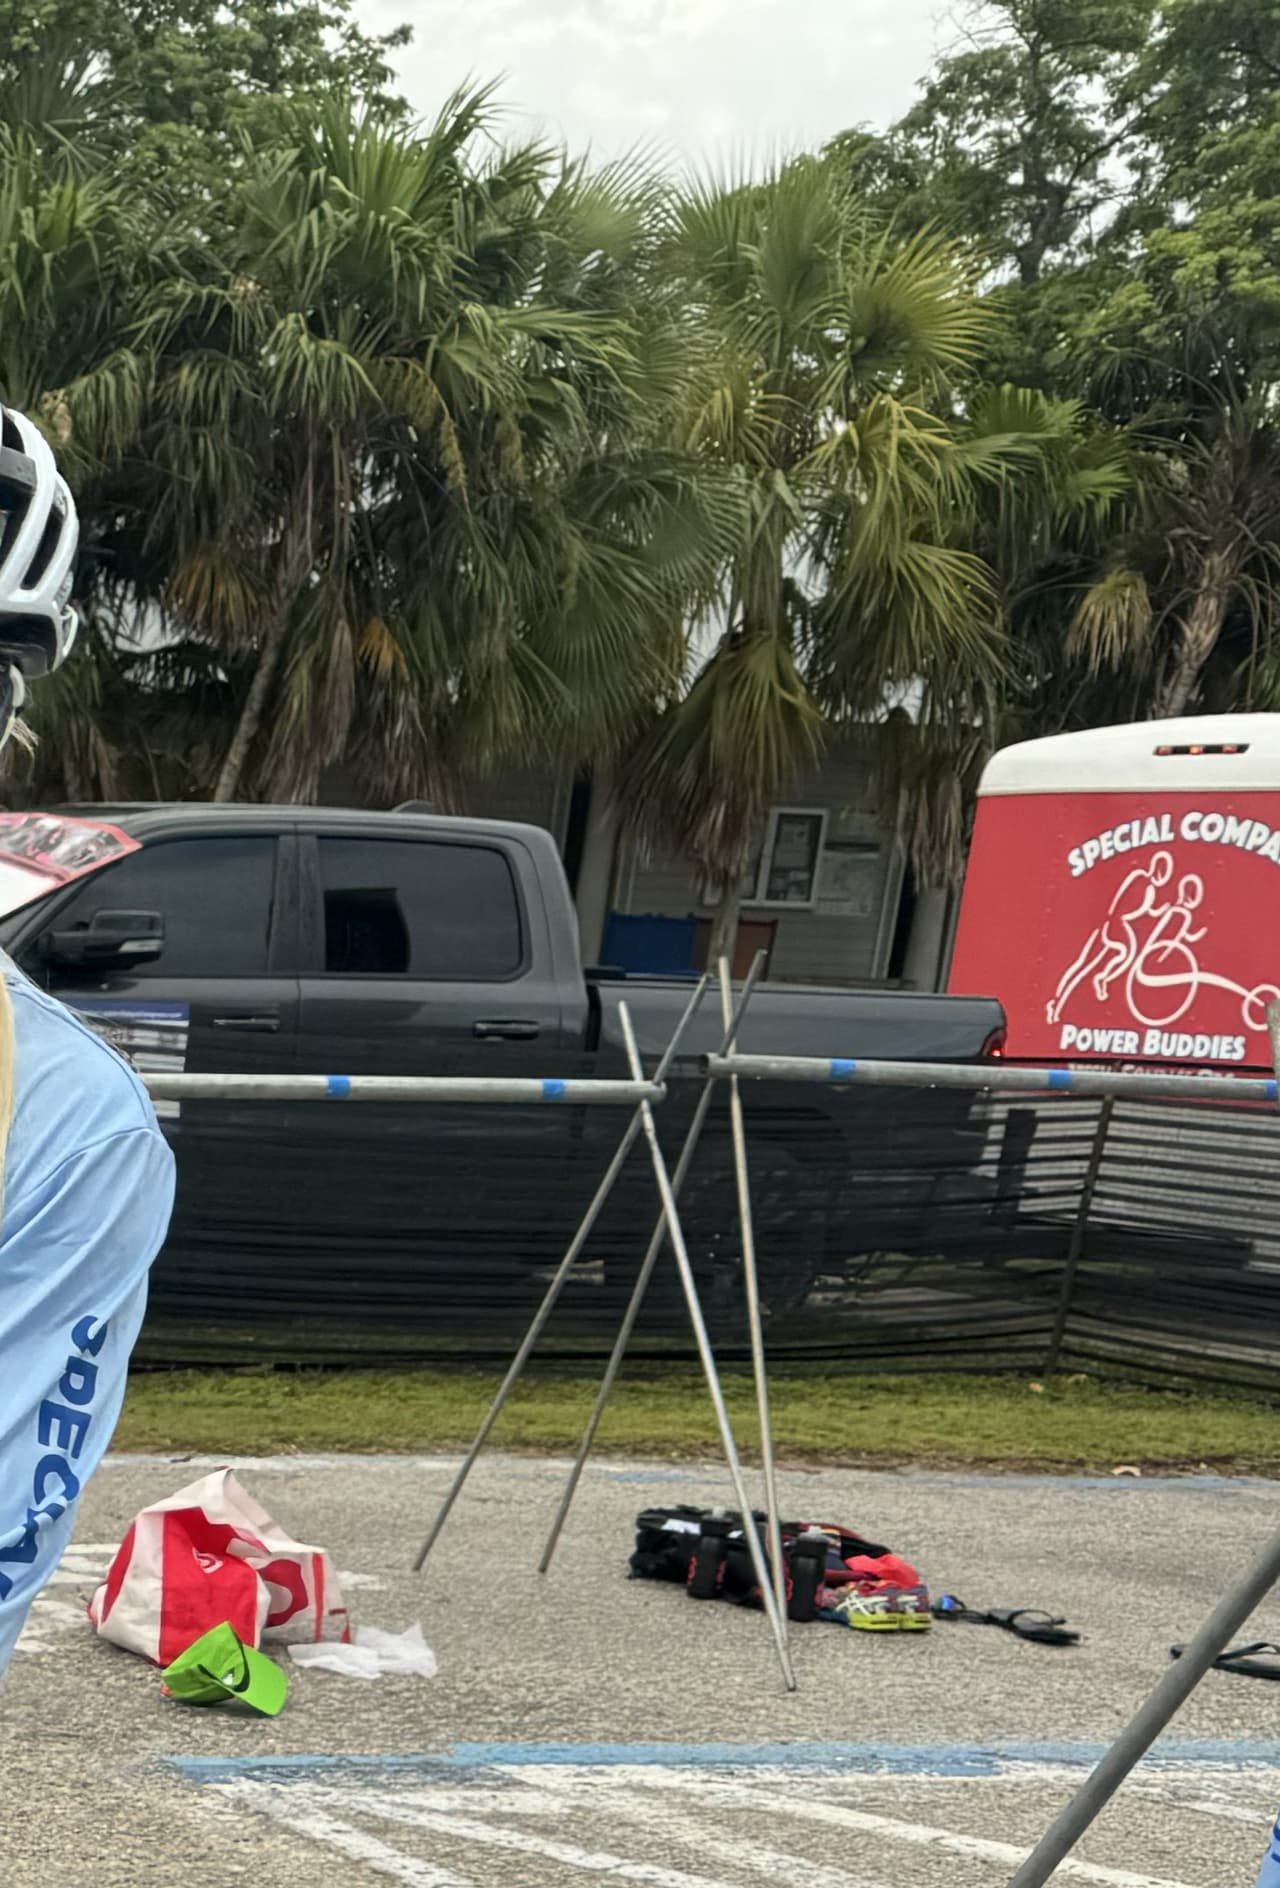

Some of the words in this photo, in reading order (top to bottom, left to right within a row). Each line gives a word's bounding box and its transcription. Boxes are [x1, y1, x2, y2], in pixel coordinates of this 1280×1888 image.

[1067, 813, 1175, 878] SPECIAL
[1180, 811, 1280, 867] COMPA
[1060, 1024, 1139, 1055] POWER
[1143, 1029, 1246, 1061] BUDDIES
